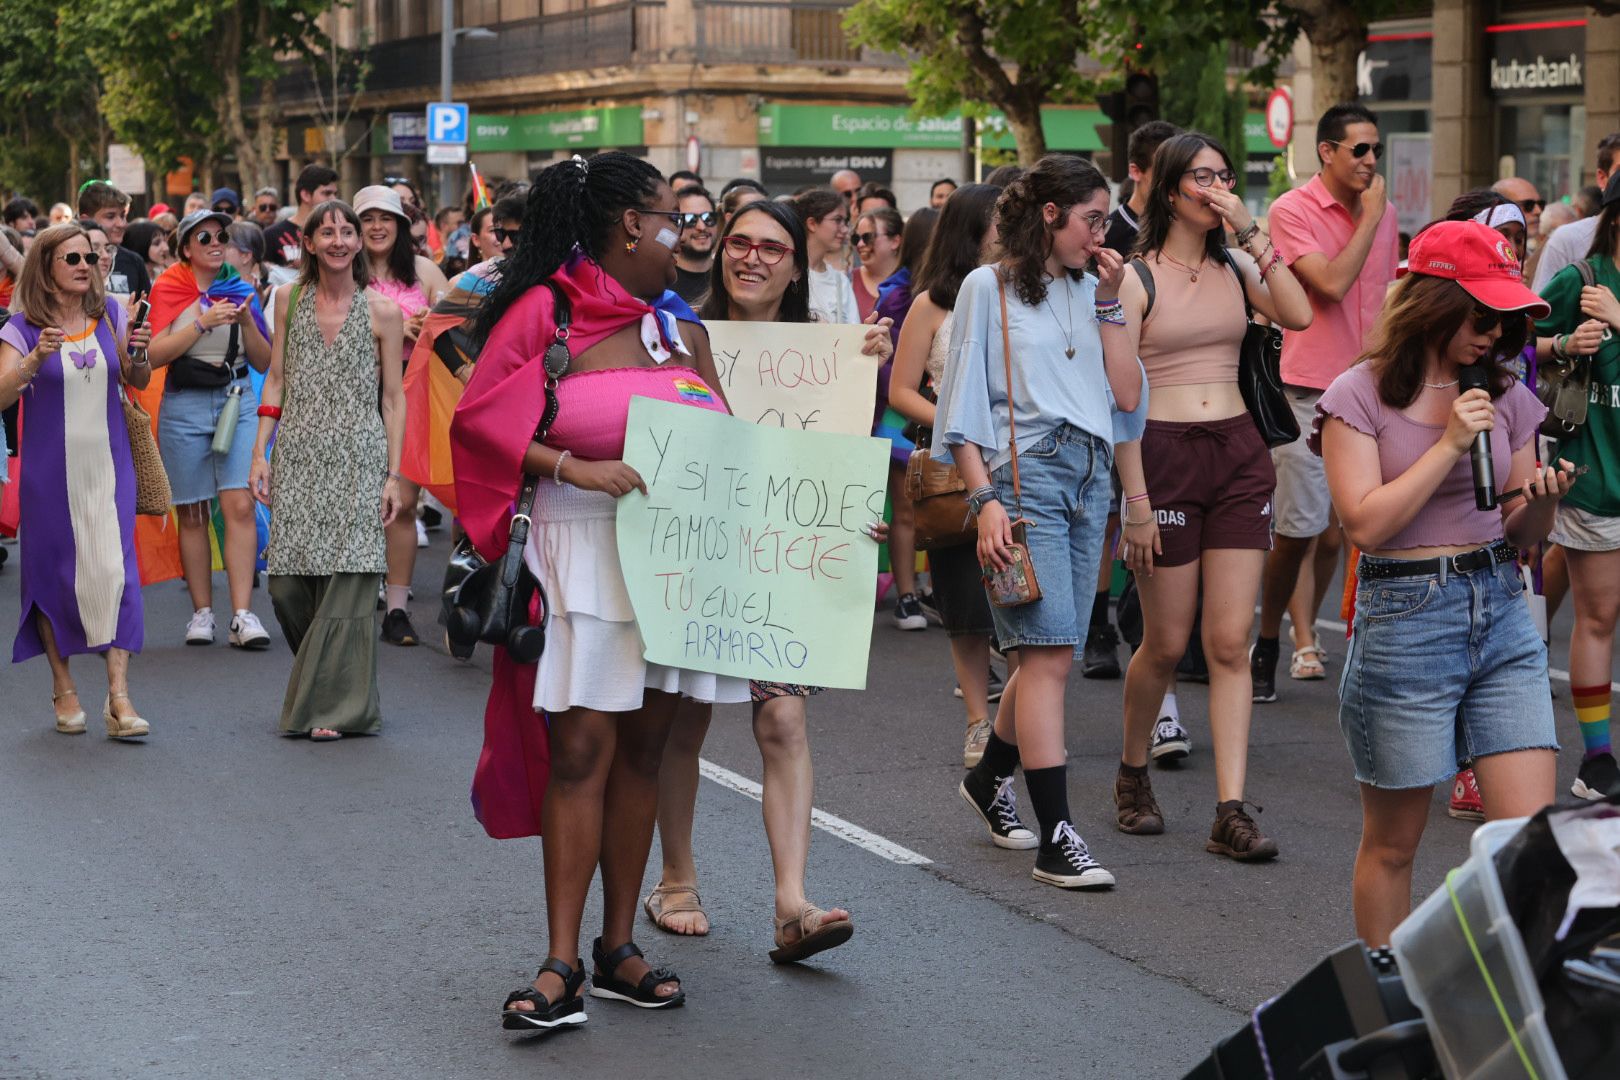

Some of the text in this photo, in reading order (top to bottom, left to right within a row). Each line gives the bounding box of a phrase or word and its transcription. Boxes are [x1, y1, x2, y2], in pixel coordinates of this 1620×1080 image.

[1491, 53, 1583, 90] kutxabank
[434, 107, 461, 139] P
[477, 125, 509, 136] DKV
[832, 114, 962, 134] Espacio de Salud
[766, 157, 803, 170] Espacio
[819, 156, 849, 168] Salud
[850, 157, 886, 168] DKV
[758, 338, 840, 388] AQUÍ
[649, 426, 672, 486] Y
[678, 462, 707, 500] SI
[724, 468, 752, 508] TE
[648, 507, 851, 580] TAMOS MÉTETE
[656, 568, 694, 611] TÚ
[685, 621, 808, 669] ARMARIO
